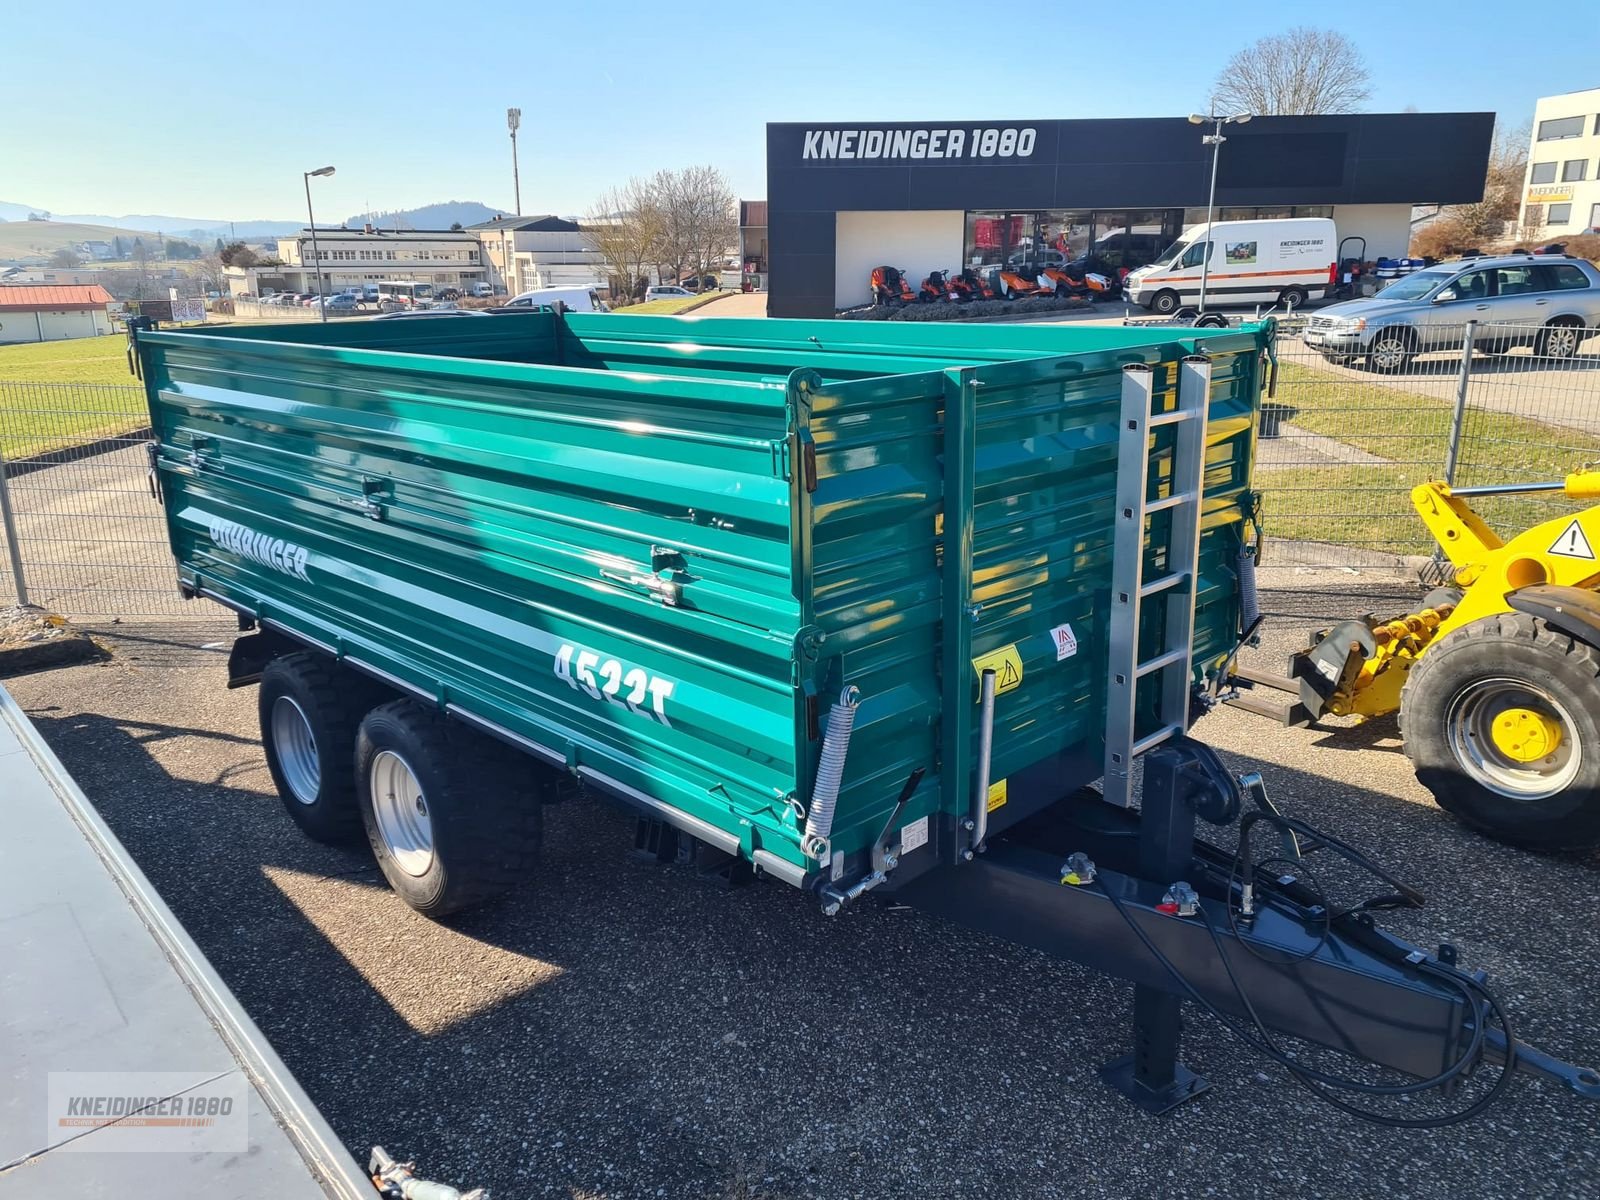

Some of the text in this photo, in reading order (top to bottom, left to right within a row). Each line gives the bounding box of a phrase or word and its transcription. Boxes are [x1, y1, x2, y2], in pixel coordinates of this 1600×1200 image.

[803, 128, 1037, 159] KNEIDINGER 1880
[553, 643, 674, 729] 4522T
